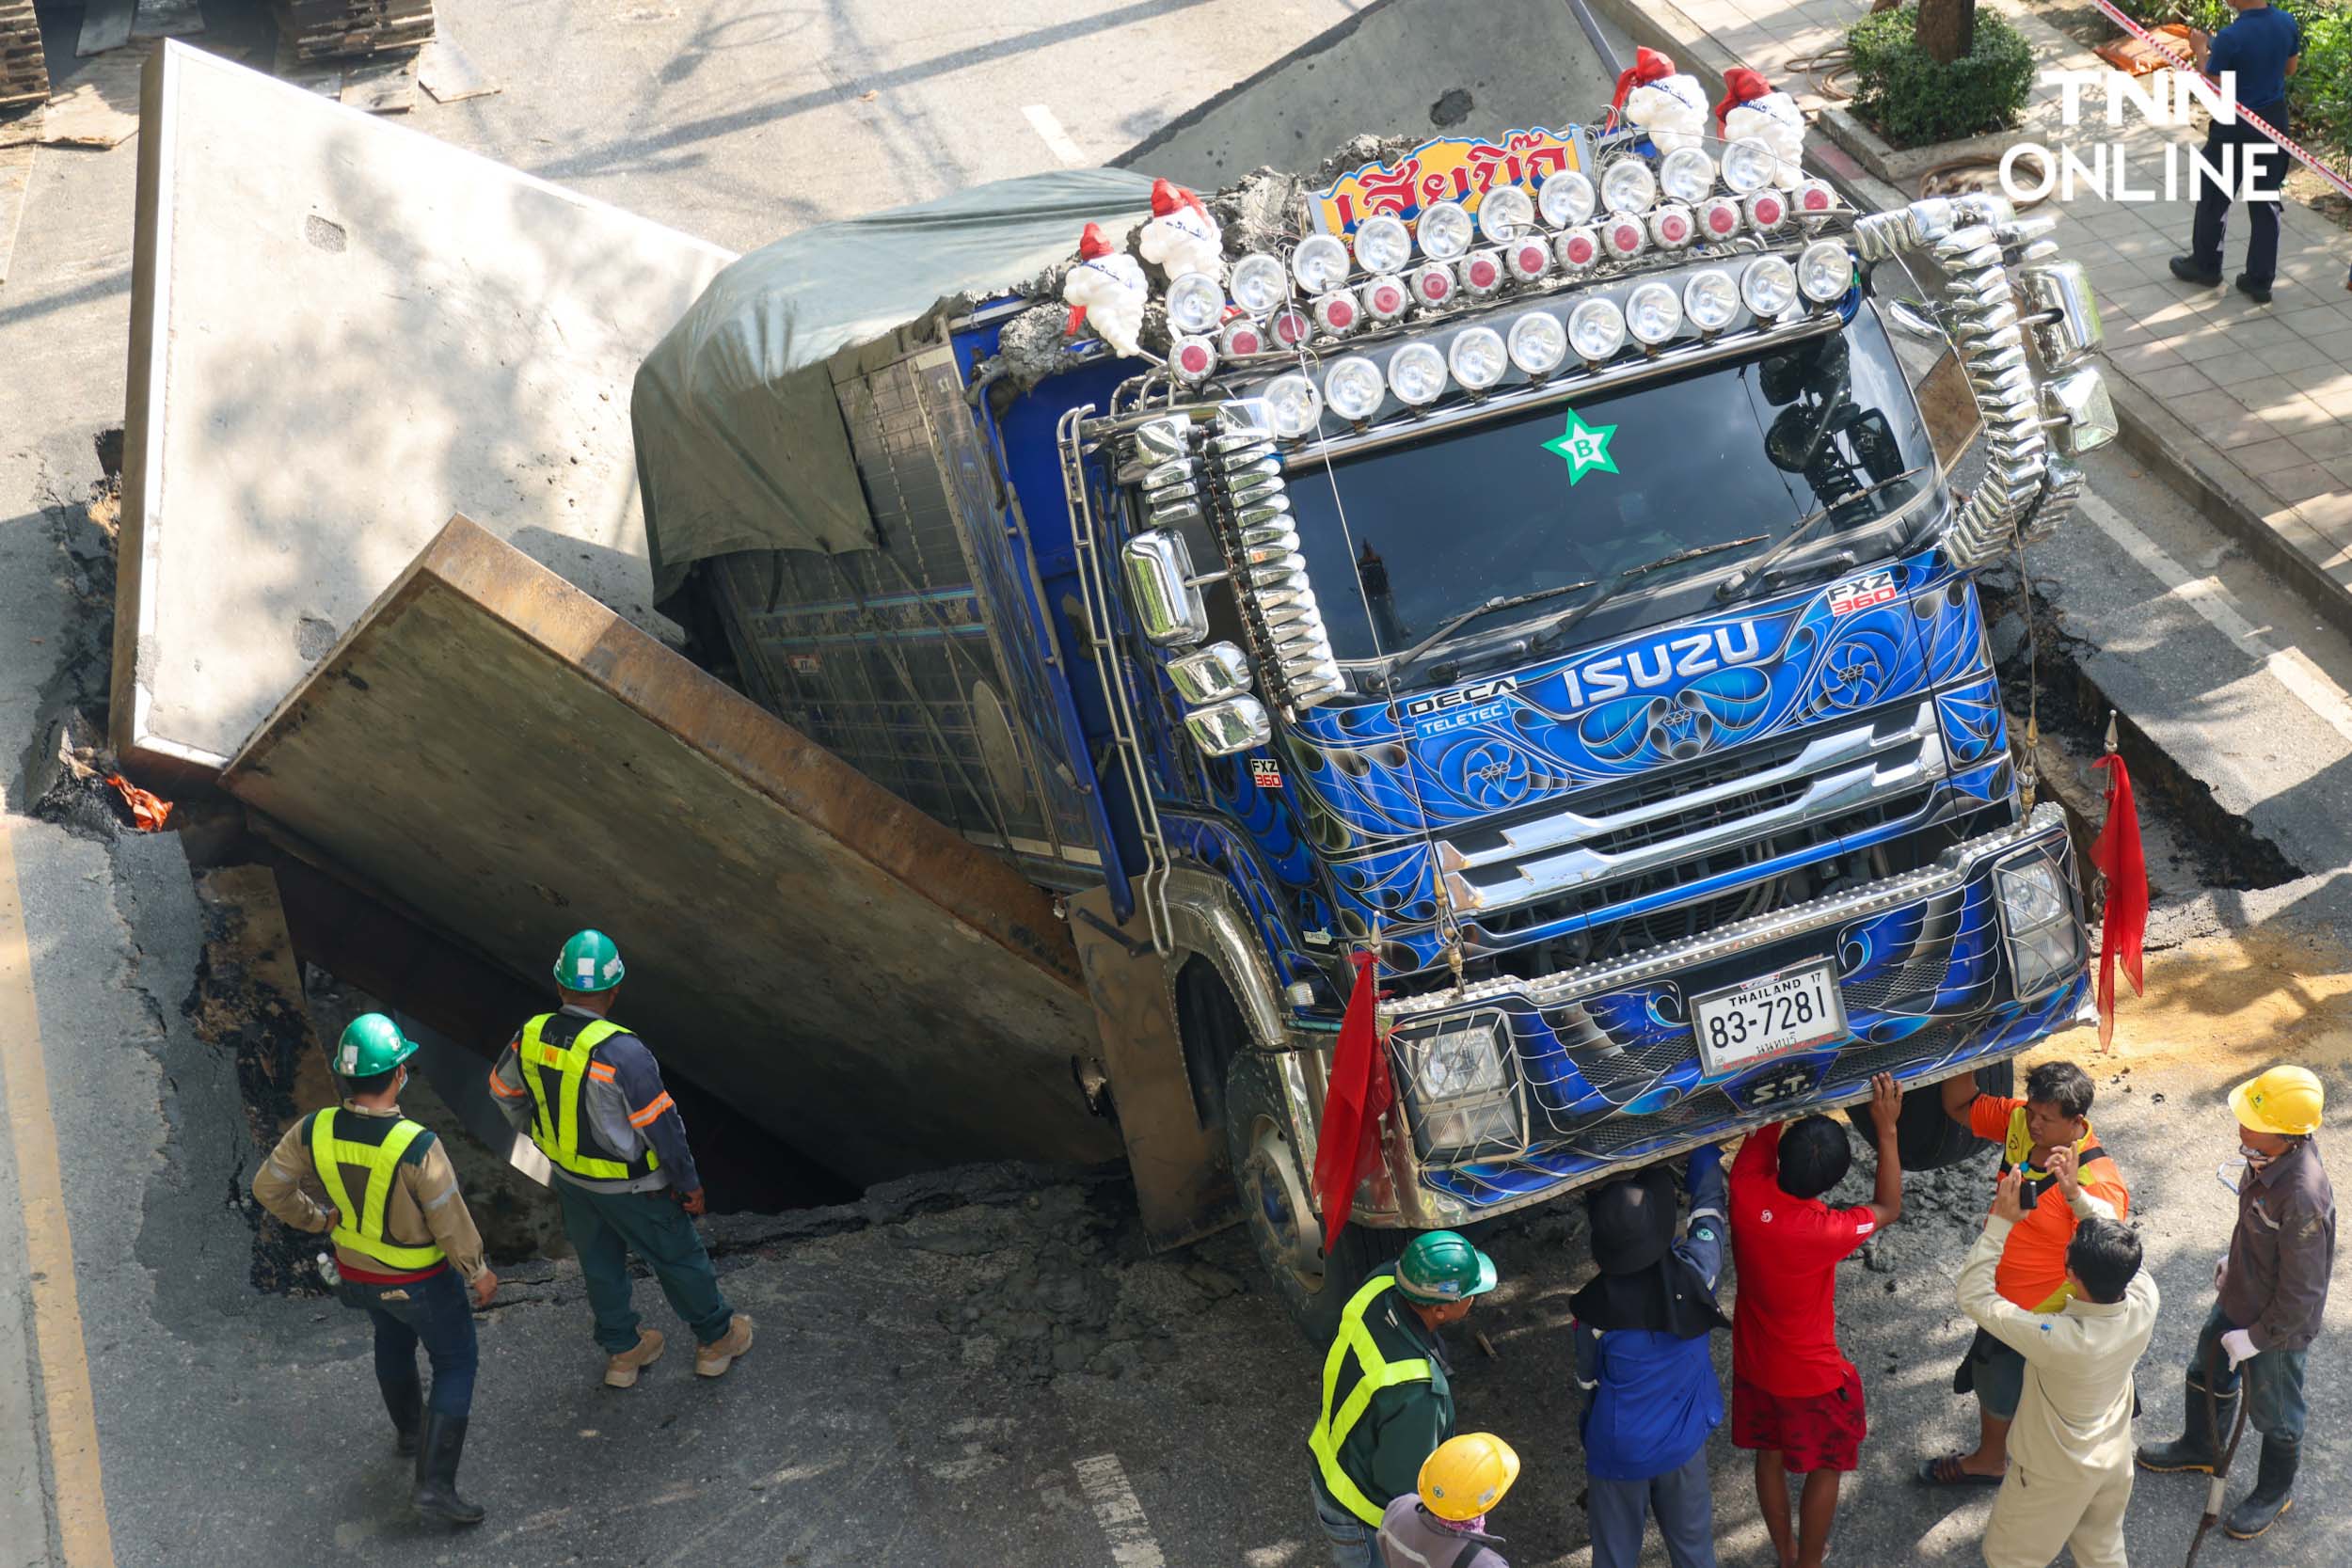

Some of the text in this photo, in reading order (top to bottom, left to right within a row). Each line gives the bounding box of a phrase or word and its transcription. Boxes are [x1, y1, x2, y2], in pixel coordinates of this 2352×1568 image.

[1574, 439, 1594, 458] B
[1828, 572, 1892, 601] FXZ
[1832, 587, 1897, 616] 360
[1563, 621, 1759, 707] ISUZU
[1408, 679, 1516, 716] DECA
[1422, 704, 1503, 734] TELETEC
[1252, 760, 1279, 772] FXZ
[1255, 774, 1281, 786] 360
[1729, 979, 1801, 1006] THAILAND
[1709, 987, 1826, 1049] 83-7281
[1756, 1031, 1798, 1053] นนทบรี
[1752, 1074, 1811, 1104] S.T.
